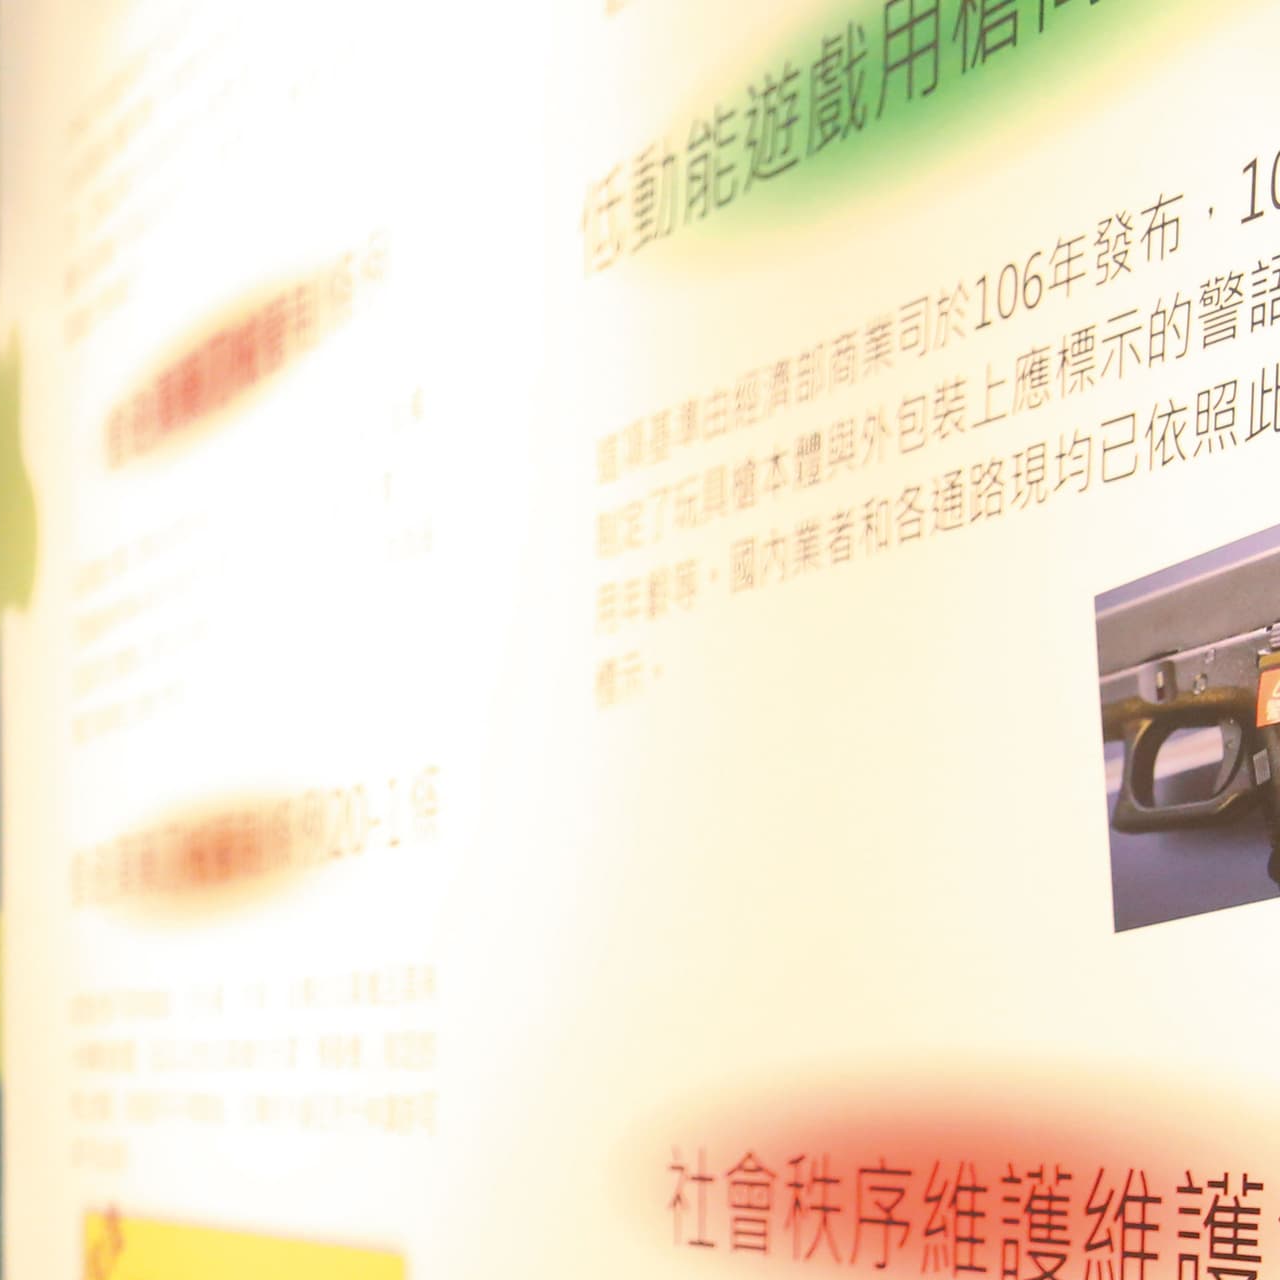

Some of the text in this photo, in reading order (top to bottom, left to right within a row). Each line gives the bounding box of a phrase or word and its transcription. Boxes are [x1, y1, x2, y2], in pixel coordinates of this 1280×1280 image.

[580, 0, 1104, 280] 低動能遊戲用槍
